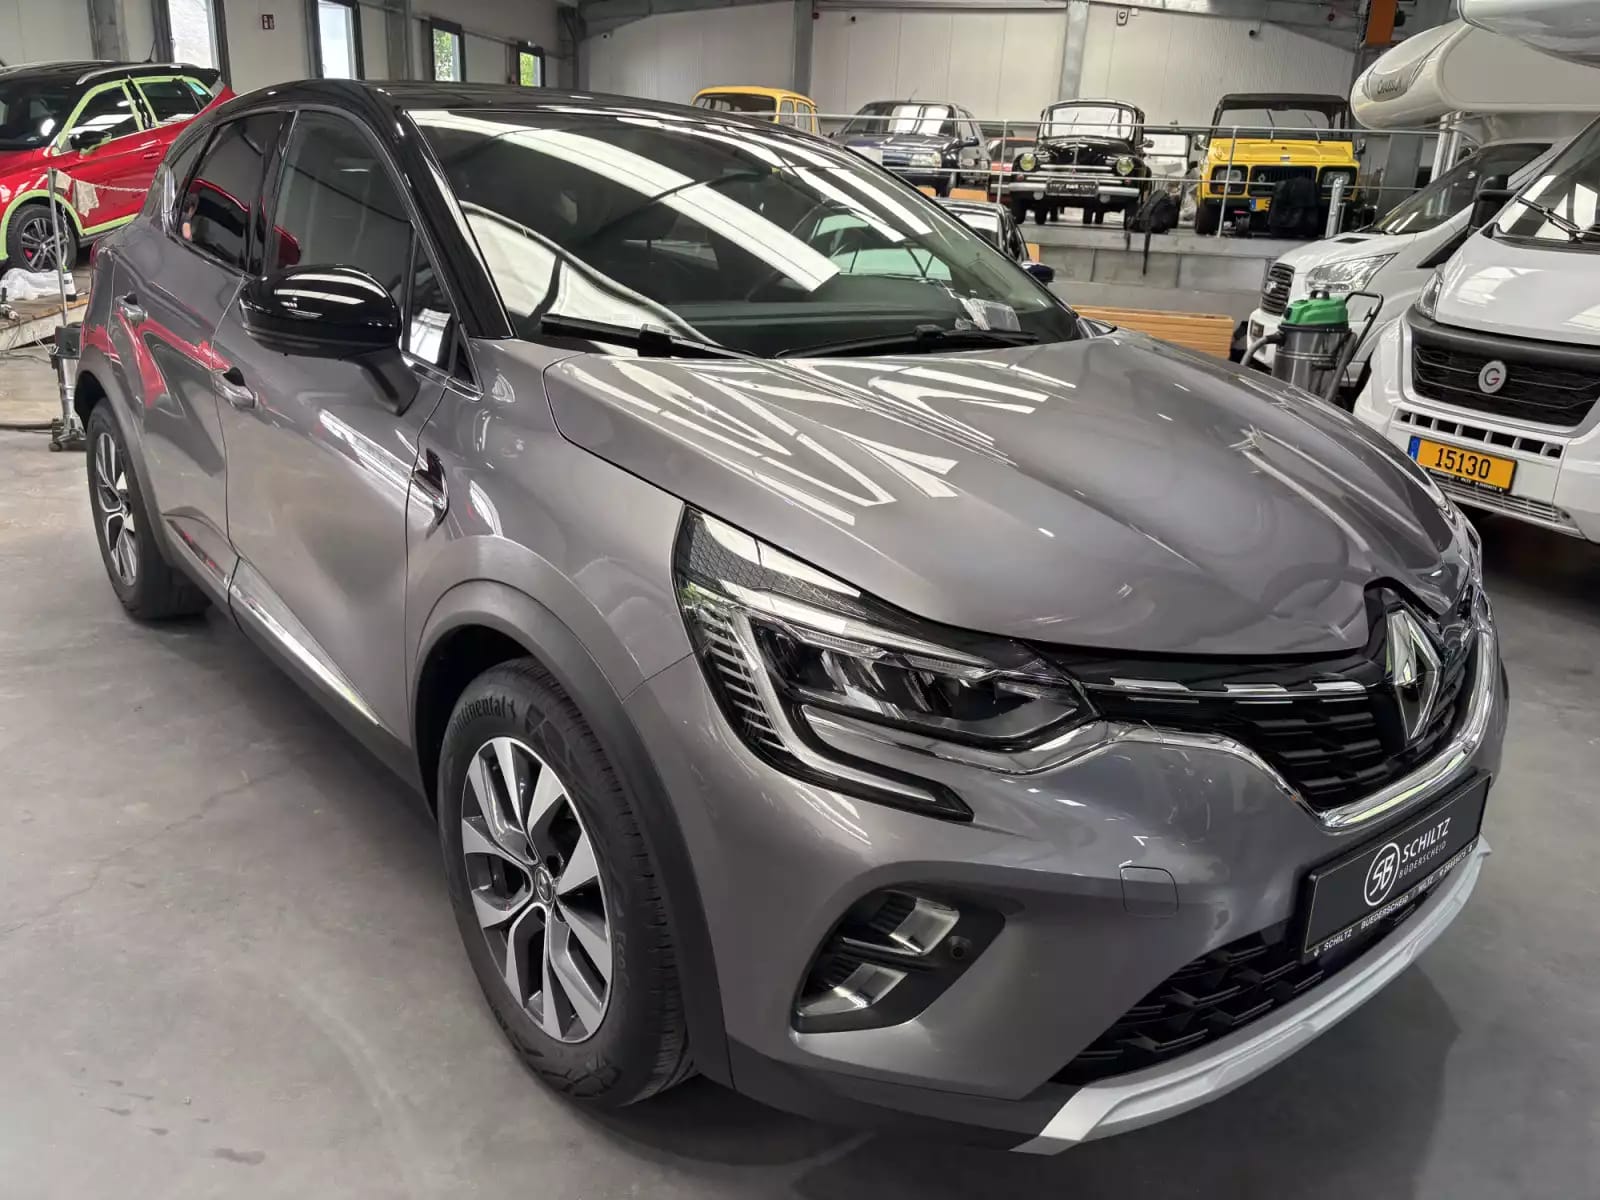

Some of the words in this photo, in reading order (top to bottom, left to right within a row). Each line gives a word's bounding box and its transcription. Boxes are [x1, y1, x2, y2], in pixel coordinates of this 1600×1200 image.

[1484, 367, 1501, 387] G
[1434, 447, 1491, 479] 15130
[1401, 817, 1452, 863] SCHILTZ
[1323, 927, 1353, 951] SCHILTZ
